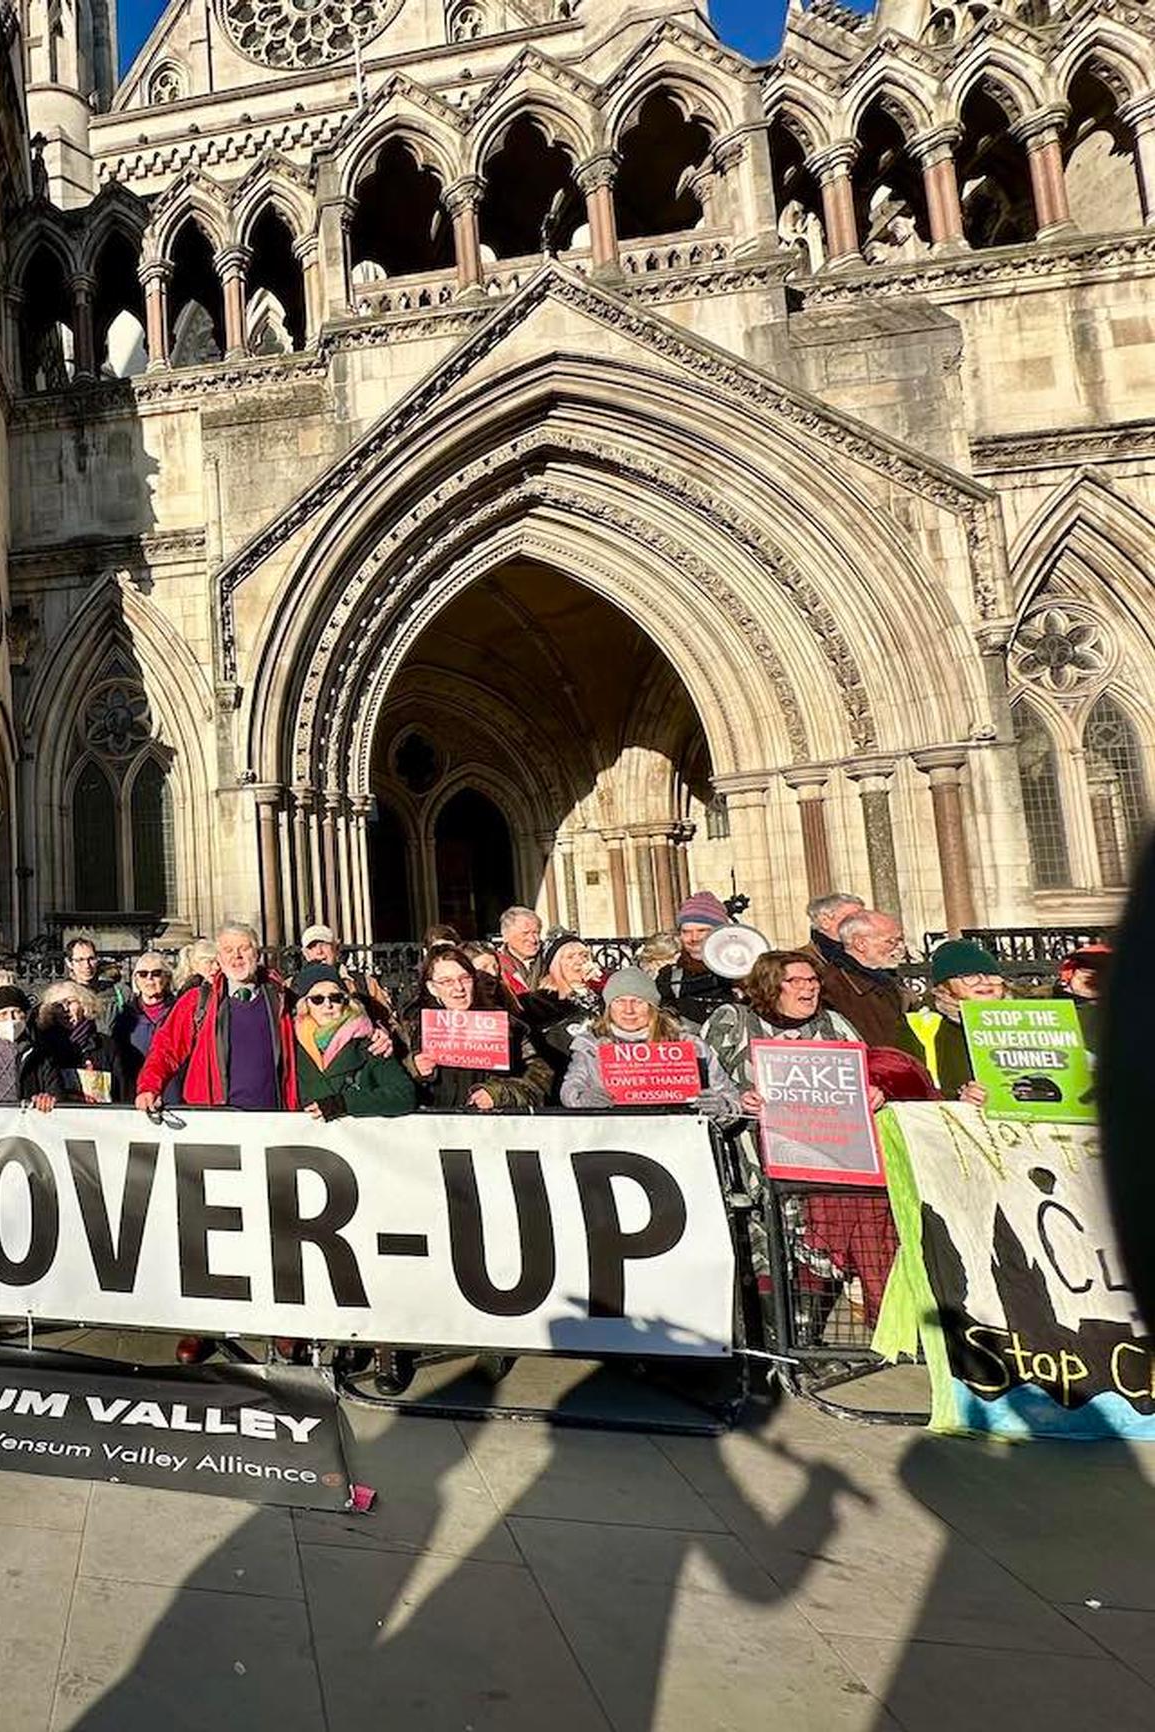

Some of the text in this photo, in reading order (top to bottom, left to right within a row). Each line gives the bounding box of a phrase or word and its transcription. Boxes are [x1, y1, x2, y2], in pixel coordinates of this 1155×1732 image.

[436, 1009, 496, 1029] NO to
[981, 1010, 1059, 1027] STOP THE
[973, 1030, 1080, 1048] SILVERTOWN
[614, 1043, 683, 1062] NO to
[832, 1055, 853, 1066] THE
[995, 1050, 1064, 1068] TUNNEL
[605, 1074, 699, 1087] LOWER THAMES
[765, 1063, 858, 1090] LAKE
[624, 1089, 684, 1101] CROSSING
[766, 1087, 859, 1105] DISTRICT
[965, 1325, 1088, 1406] Stop
[84, 1395, 323, 1444] VALLEY
[101, 1443, 189, 1472] Valley
[195, 1453, 318, 1485] Alliance
